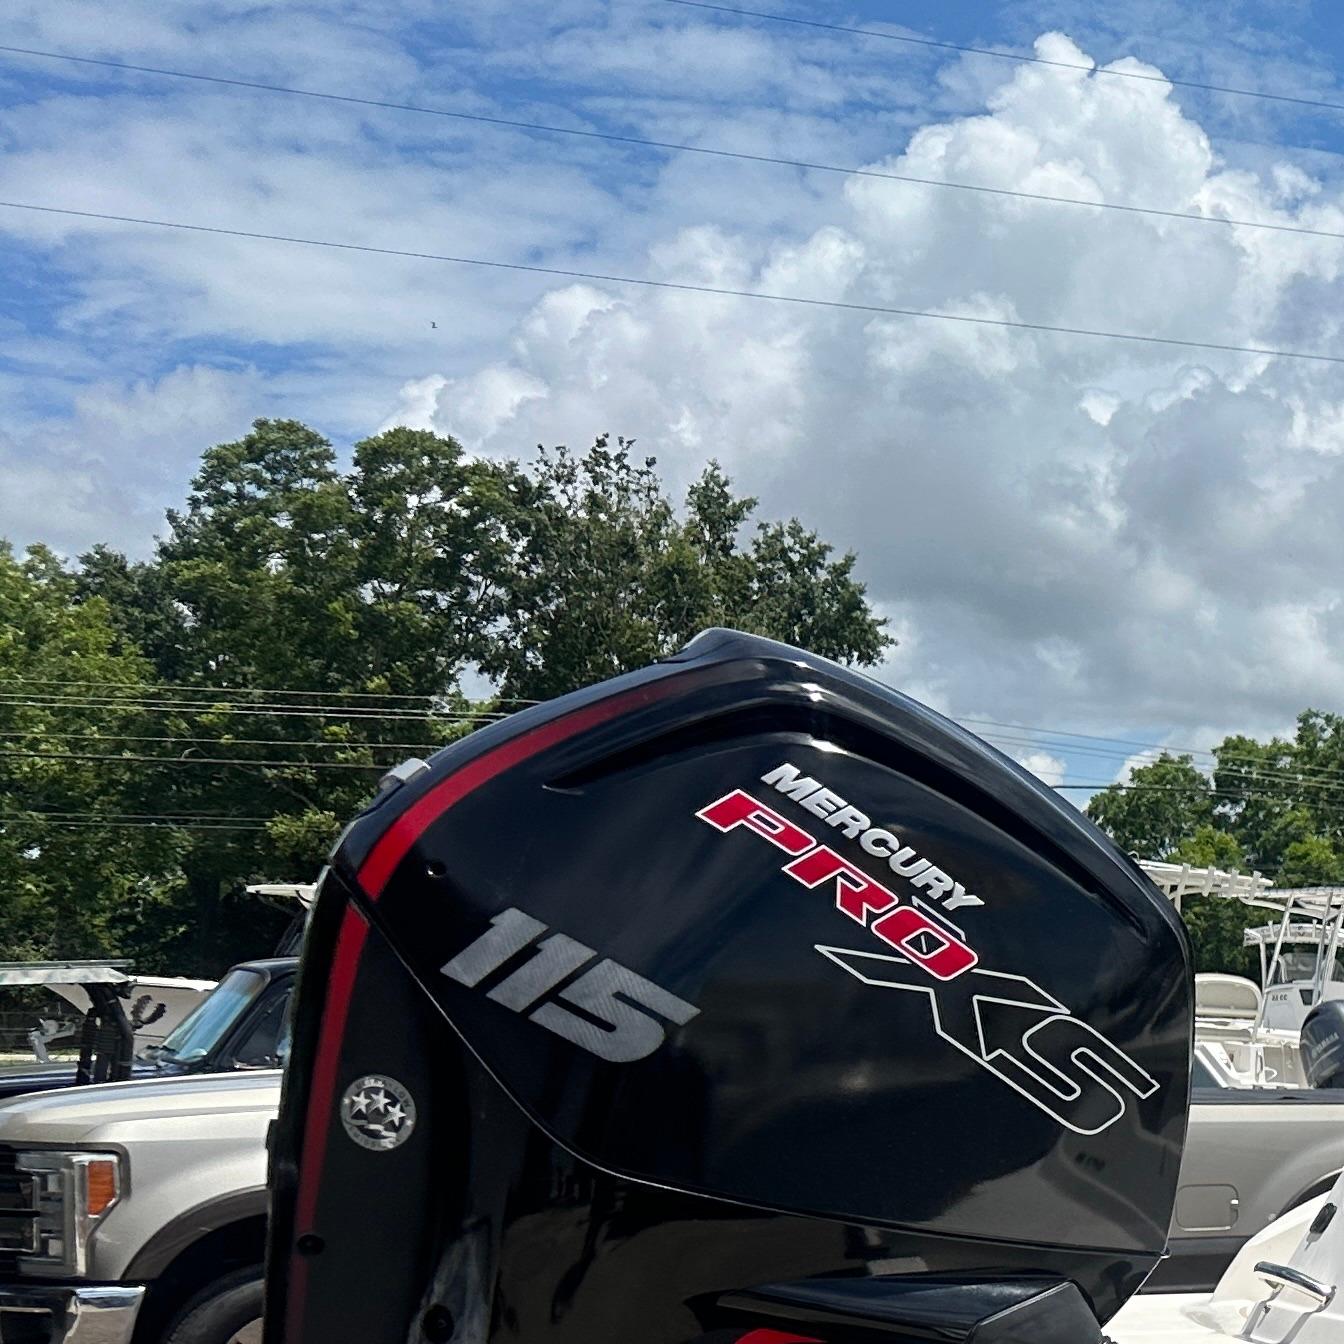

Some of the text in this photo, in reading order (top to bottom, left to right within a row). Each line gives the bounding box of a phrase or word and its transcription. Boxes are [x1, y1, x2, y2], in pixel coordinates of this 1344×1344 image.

[694, 789, 979, 981] PRO
[760, 762, 985, 912] MERCURY
[439, 905, 702, 1064] 115
[813, 895, 1161, 1136] XS
